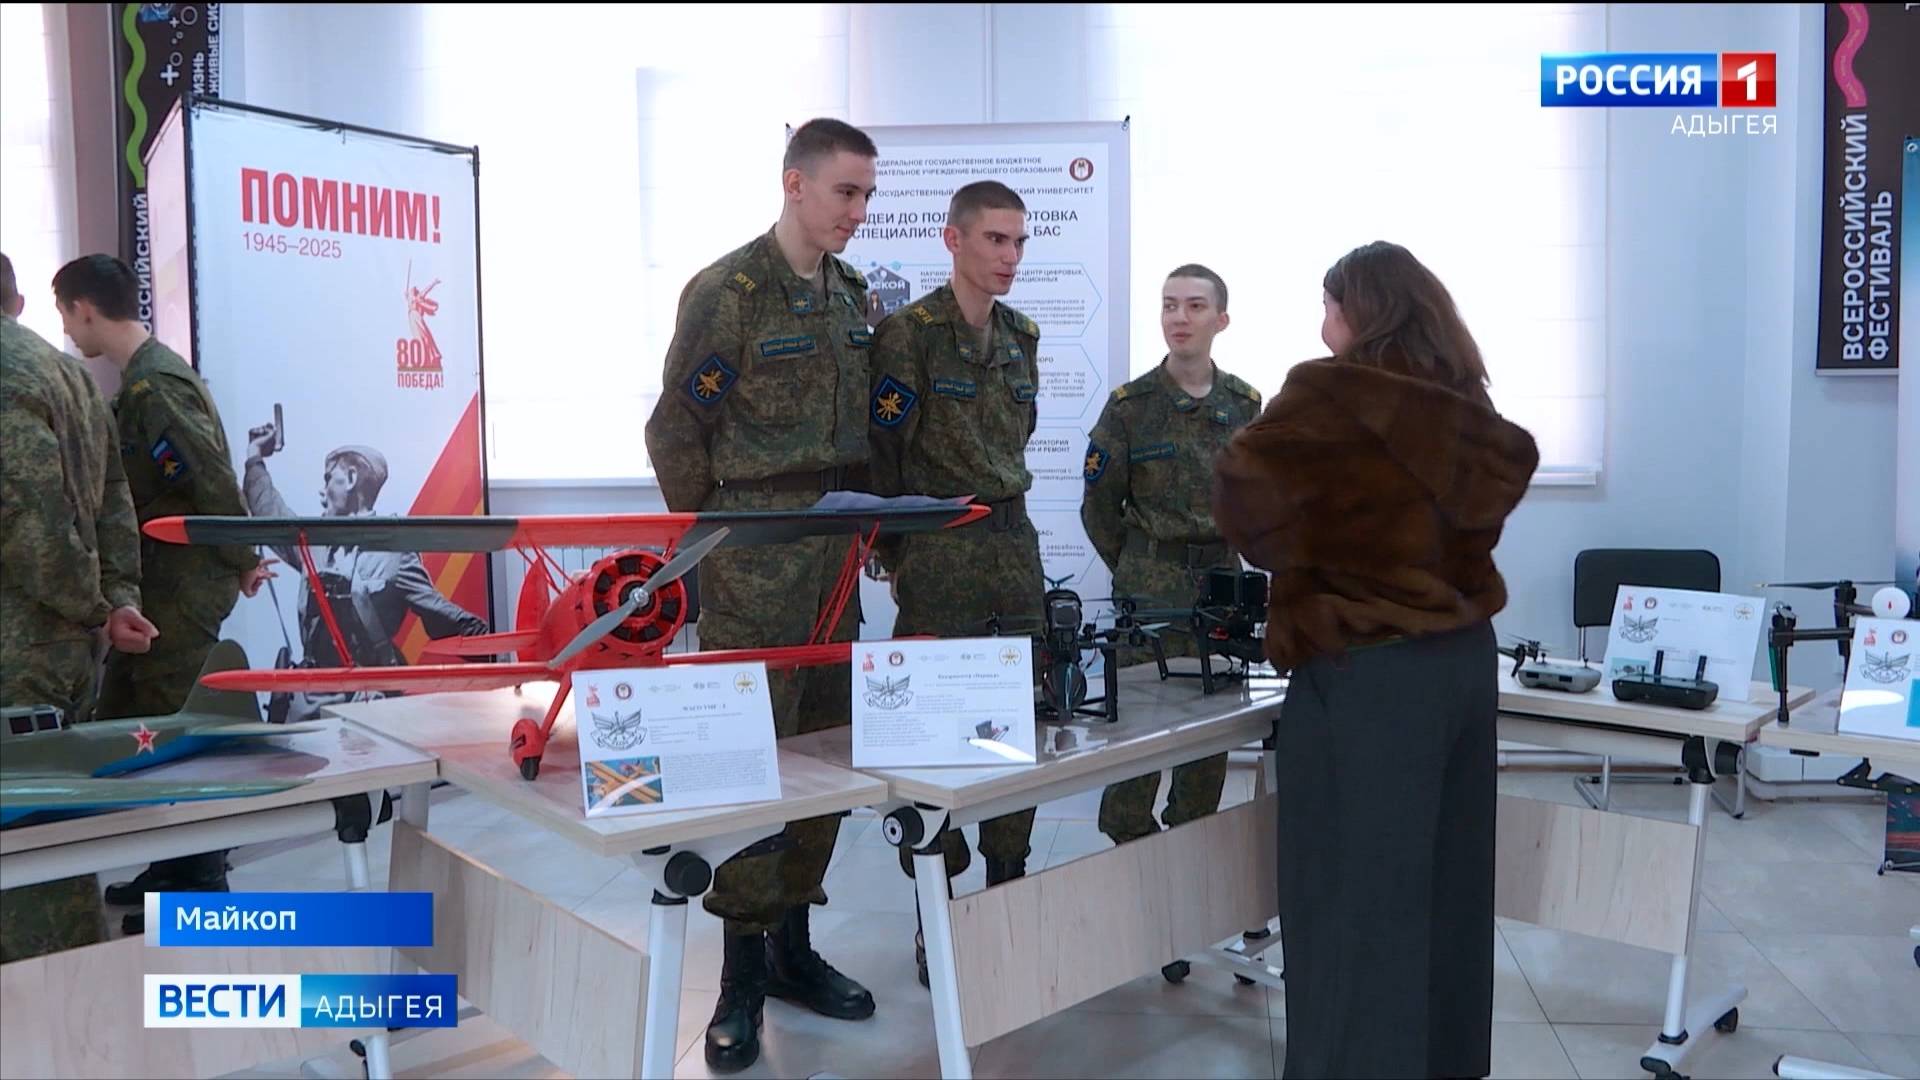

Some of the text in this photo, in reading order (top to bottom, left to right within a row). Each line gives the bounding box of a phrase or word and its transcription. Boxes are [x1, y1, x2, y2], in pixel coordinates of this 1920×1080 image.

[192, 52, 205, 94] ИЗНЬ
[207, 34, 219, 94] ЖИВЫЕ
[876, 157, 1042, 168] ЕДЕРАЛЬНОЕ ГОСУДАРСТВЕННОЕ БЮДЖЕТНОЕ
[922, 167, 970, 176] УЧРЕЖДЕНИЕ
[971, 166, 1008, 176] ВЫСШЕГО
[1009, 166, 1063, 175] ОБРАЗОВАНИЯ
[876, 187, 954, 198] ГОСУДАРСТВЕННЫЙ
[1037, 186, 1094, 196] УНИВЕРСИТЕТ
[241, 167, 441, 244] ПОМНИМ!
[866, 212, 894, 226] ДЕИ
[898, 212, 918, 225] ДО
[852, 225, 1062, 240] СПЕЦИАЛИСТ БАС
[1840, 114, 1867, 361] ВСЕРОССИЙСКИЙ
[133, 192, 152, 333] ОССИЙСКИЙ
[1021, 270, 1043, 278] ЦЕНТР
[1867, 190, 1893, 361] ФЕСТИВАЛЬ
[871, 280, 906, 292] СКОЙ
[396, 338, 422, 369] 80
[397, 372, 444, 391] ПОБЕДА!
